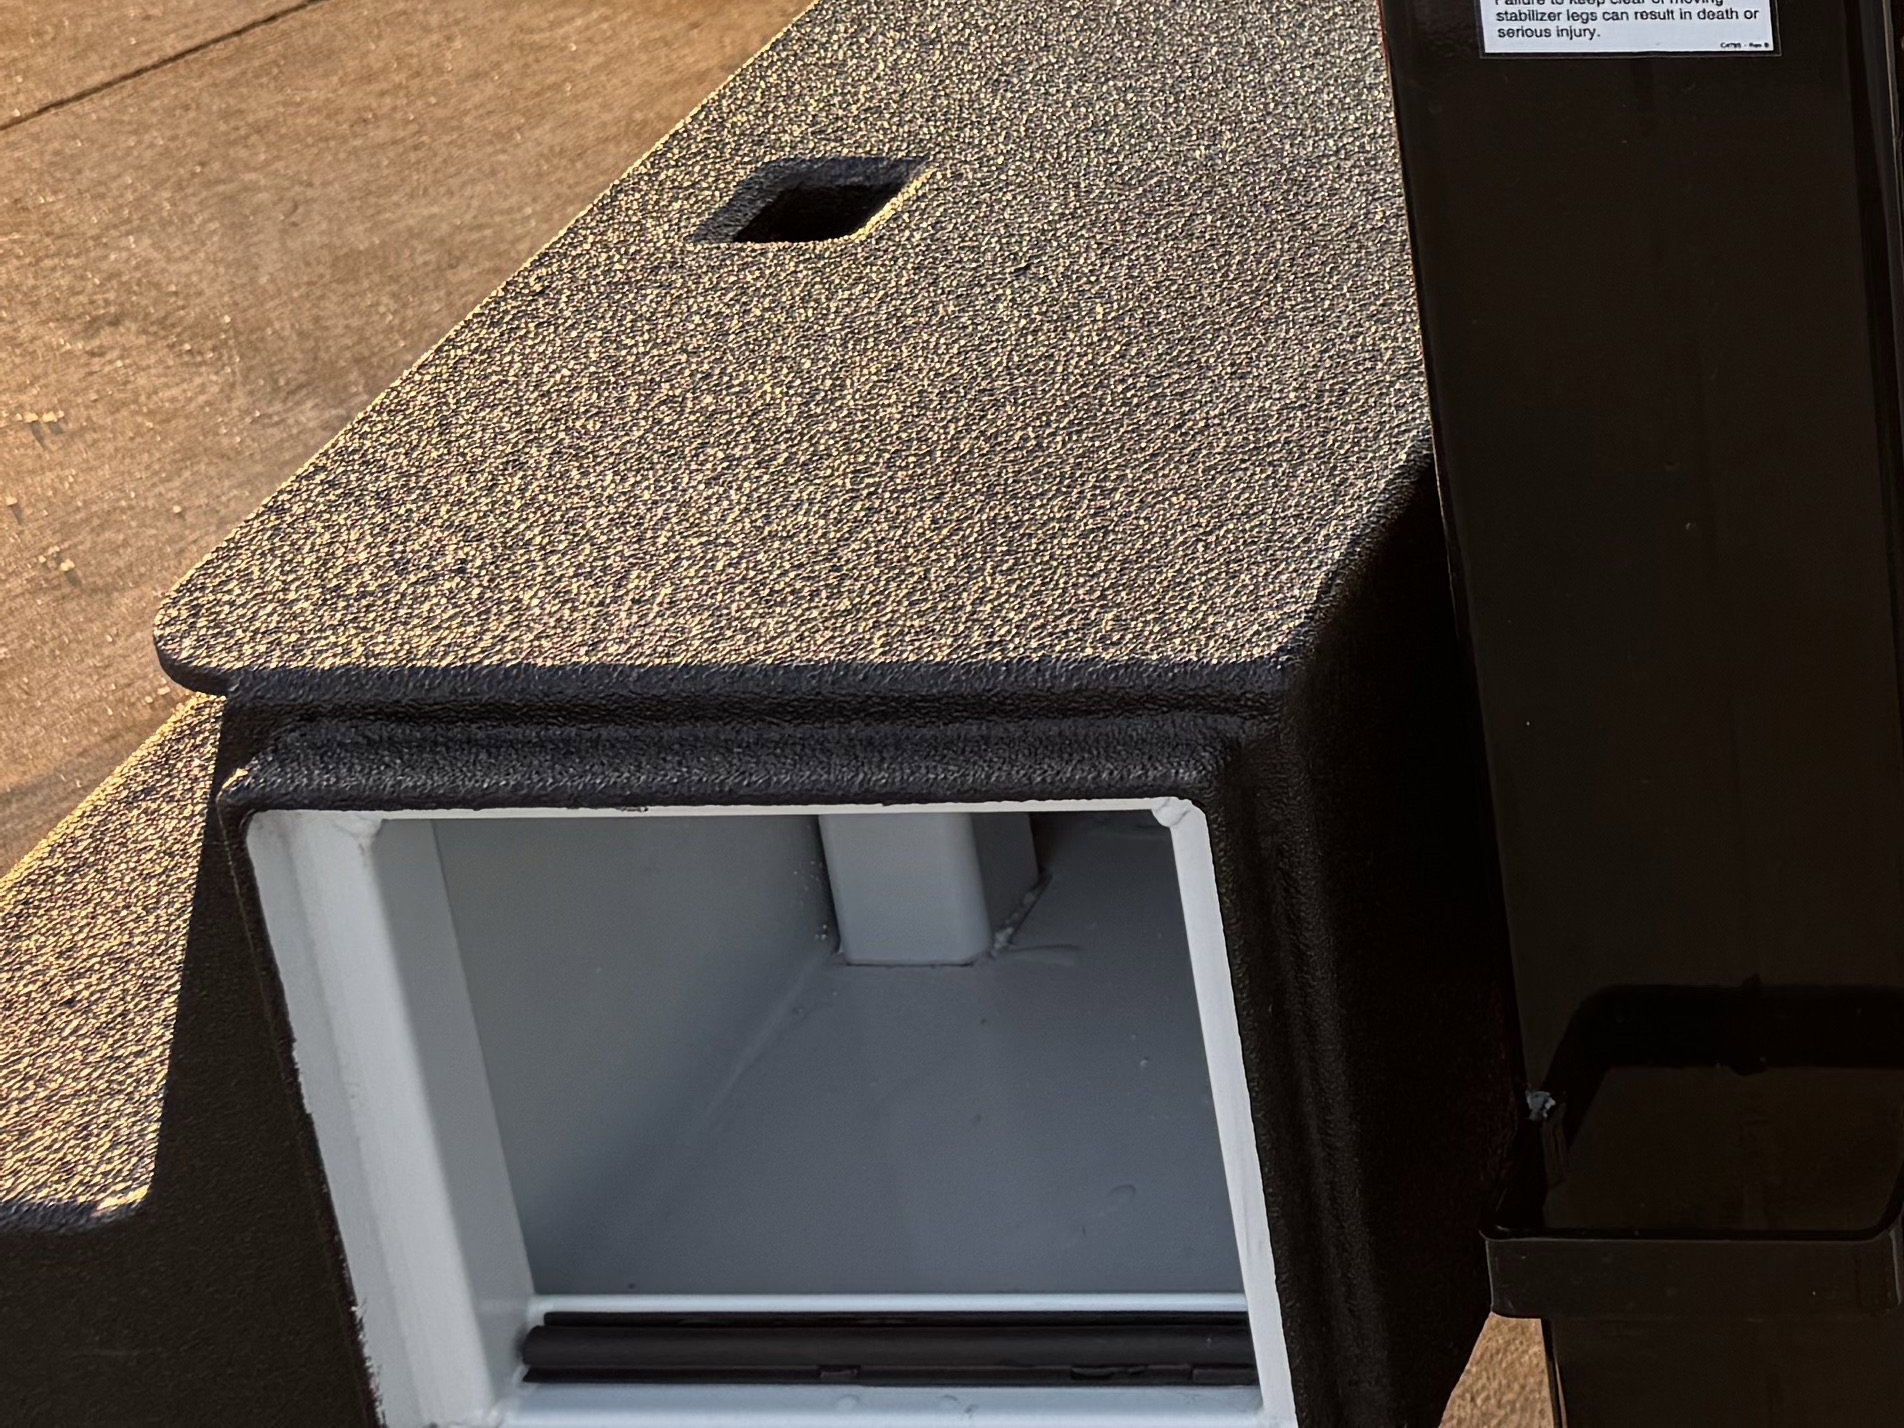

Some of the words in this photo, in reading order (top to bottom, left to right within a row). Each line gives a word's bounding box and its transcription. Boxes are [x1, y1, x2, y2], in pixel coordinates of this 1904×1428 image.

[1496, 8, 1562, 22] stabilizer
[1566, 8, 1598, 24] legs
[1602, 9, 1629, 21] can
[1633, 8, 1676, 21] result
[1679, 8, 1693, 21] in
[1697, 7, 1739, 21] death
[1743, 8, 1759, 20] or
[1497, 24, 1552, 38] serious
[1556, 25, 1600, 41] injury.
